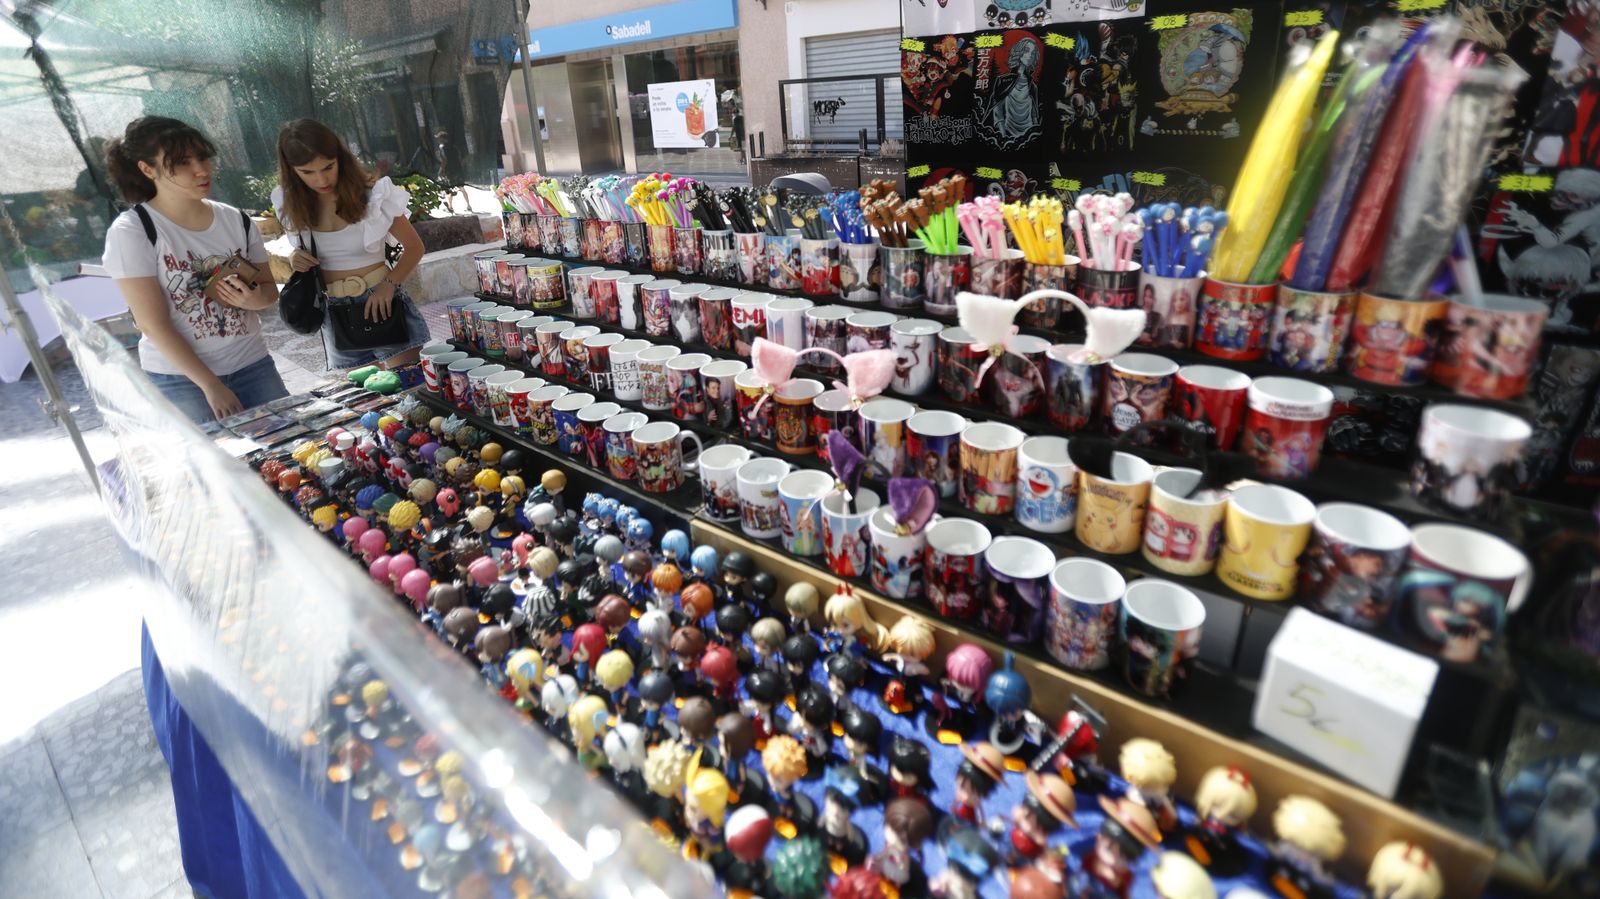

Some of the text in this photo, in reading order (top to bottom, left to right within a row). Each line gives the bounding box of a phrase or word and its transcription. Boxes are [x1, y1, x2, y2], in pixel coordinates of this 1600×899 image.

[1163, 17, 1177, 26] 08
[612, 20, 651, 39] Sabadell
[983, 37, 993, 45] 06
[1054, 36, 1066, 45] 07
[984, 168, 993, 177] 10
[1142, 174, 1154, 183] 12
[1513, 177, 1534, 190] 31
